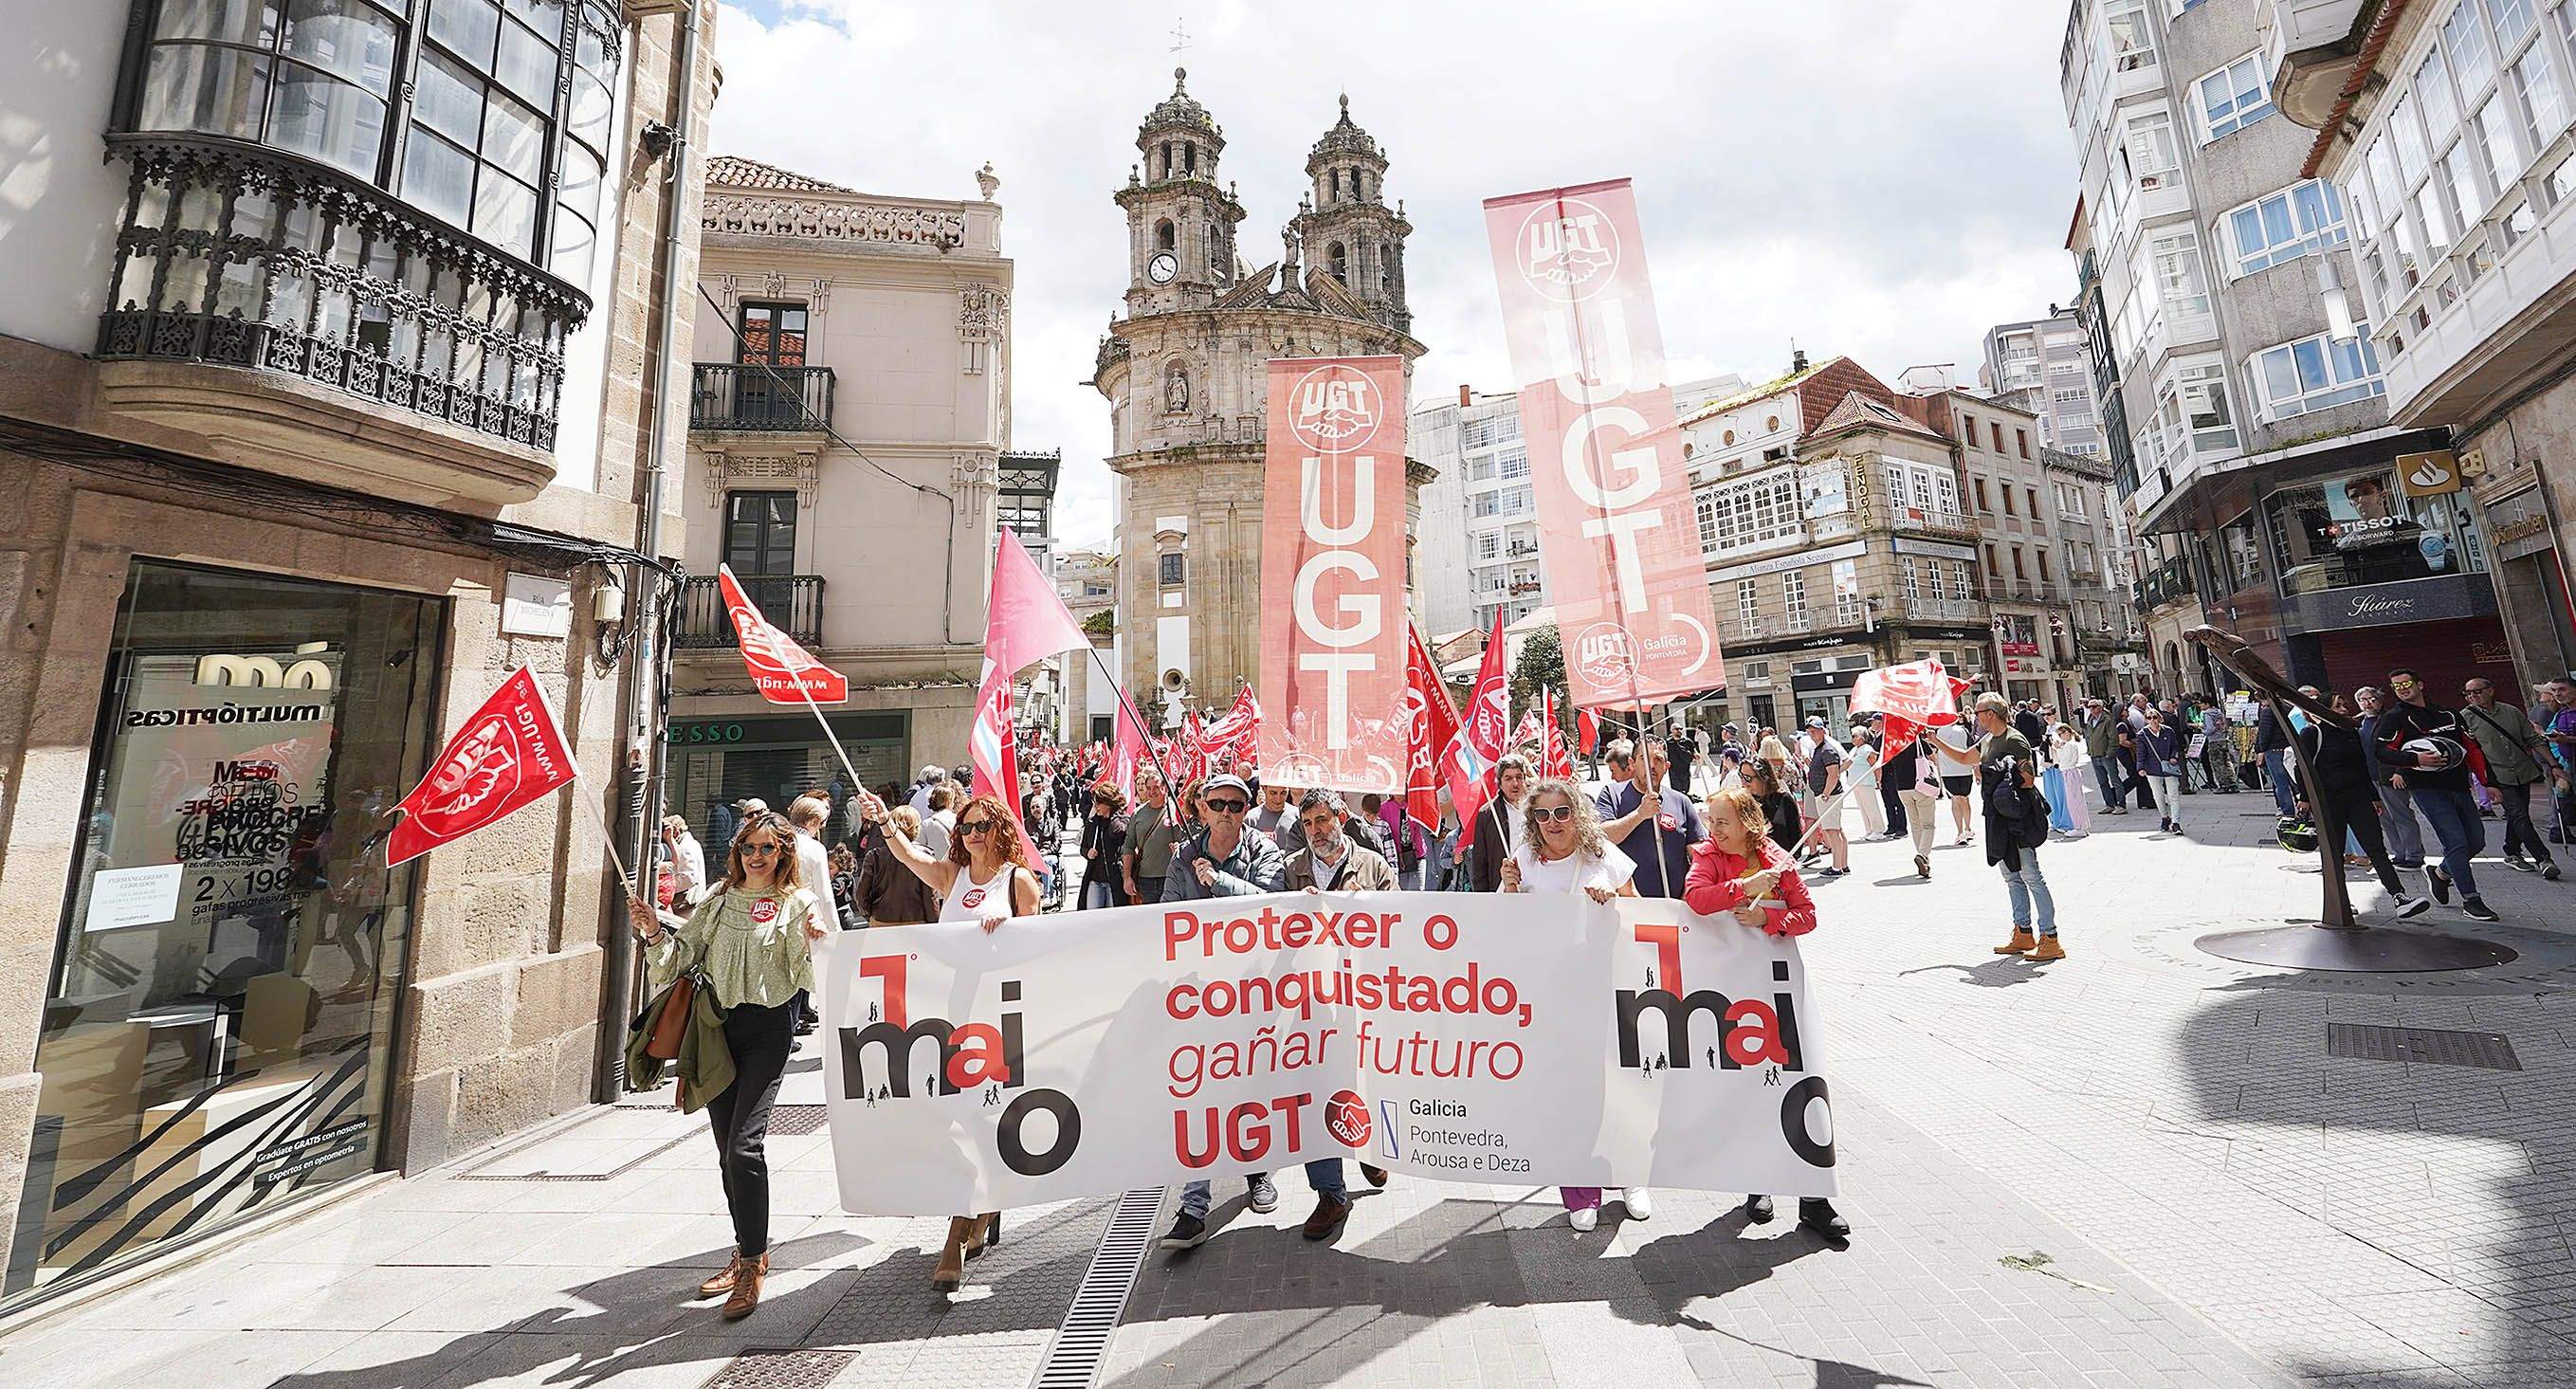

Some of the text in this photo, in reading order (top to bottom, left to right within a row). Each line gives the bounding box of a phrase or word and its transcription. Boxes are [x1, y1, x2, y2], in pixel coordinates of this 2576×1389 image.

[1530, 213, 1599, 254] UGT
[1299, 380, 1370, 405] UGT
[1543, 299, 1663, 614] UGT
[1853, 454, 1873, 529] FENOGAL
[2340, 515, 2402, 534] TISSOT
[1292, 456, 1382, 751] UGT
[1581, 633, 1628, 662] UGT
[1643, 636, 1688, 651] Galicia
[433, 719, 502, 794] UGT
[1279, 765, 1322, 784] UGT
[194, 875, 215, 902] 2
[192, 901, 226, 917] gafas
[756, 901, 775, 911] UGT
[1164, 907, 1459, 960] Protexer o
[1165, 959, 1533, 1028] conquistado,
[1167, 1019, 1525, 1098] gañar futuro
[1409, 1099, 1468, 1119] Galicia
[256, 1121, 367, 1163] Gradúate GRATIS con nosotros
[1174, 1092, 1313, 1169] UGT
[1409, 1125, 1509, 1150] Pontevedra,
[267, 1144, 356, 1182] Expertos en optometría
[1410, 1151, 1531, 1174] Arousa e Deza
